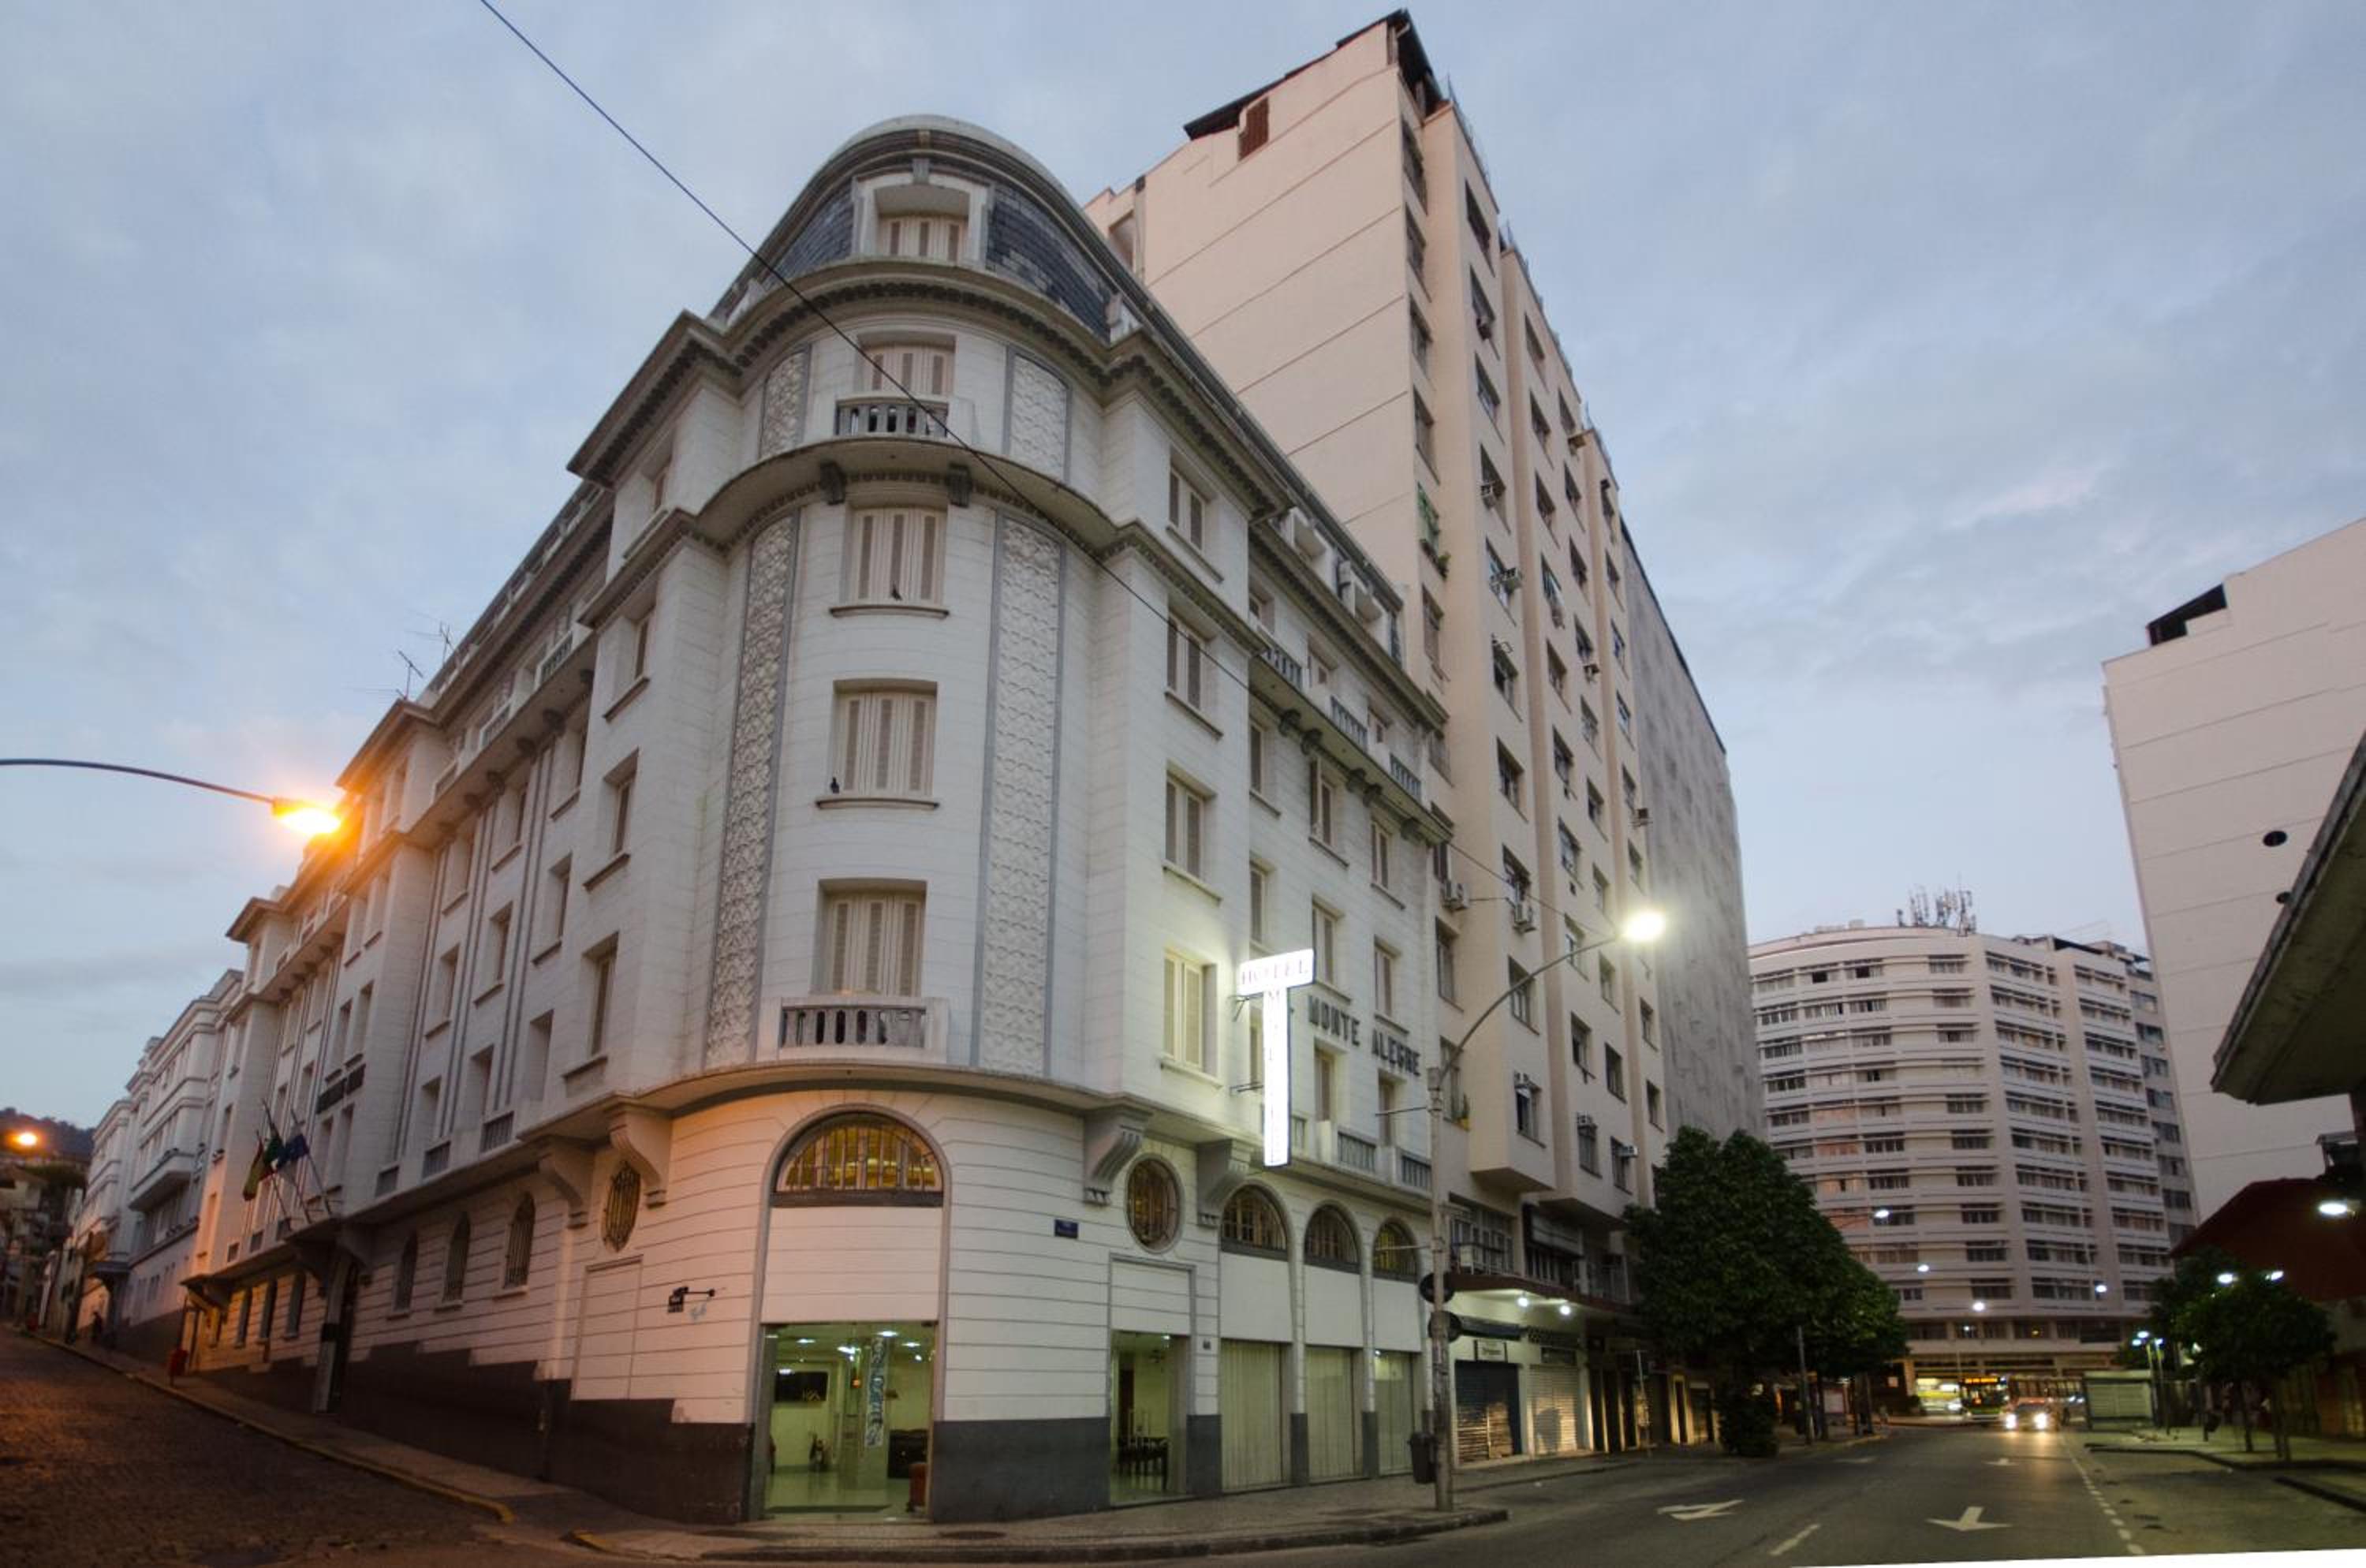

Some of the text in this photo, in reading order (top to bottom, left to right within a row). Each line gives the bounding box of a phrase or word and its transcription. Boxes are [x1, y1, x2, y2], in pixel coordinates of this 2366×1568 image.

[1241, 958, 1309, 985] HOTEL
[1308, 995, 1421, 1077] MONTE ALEGRE
